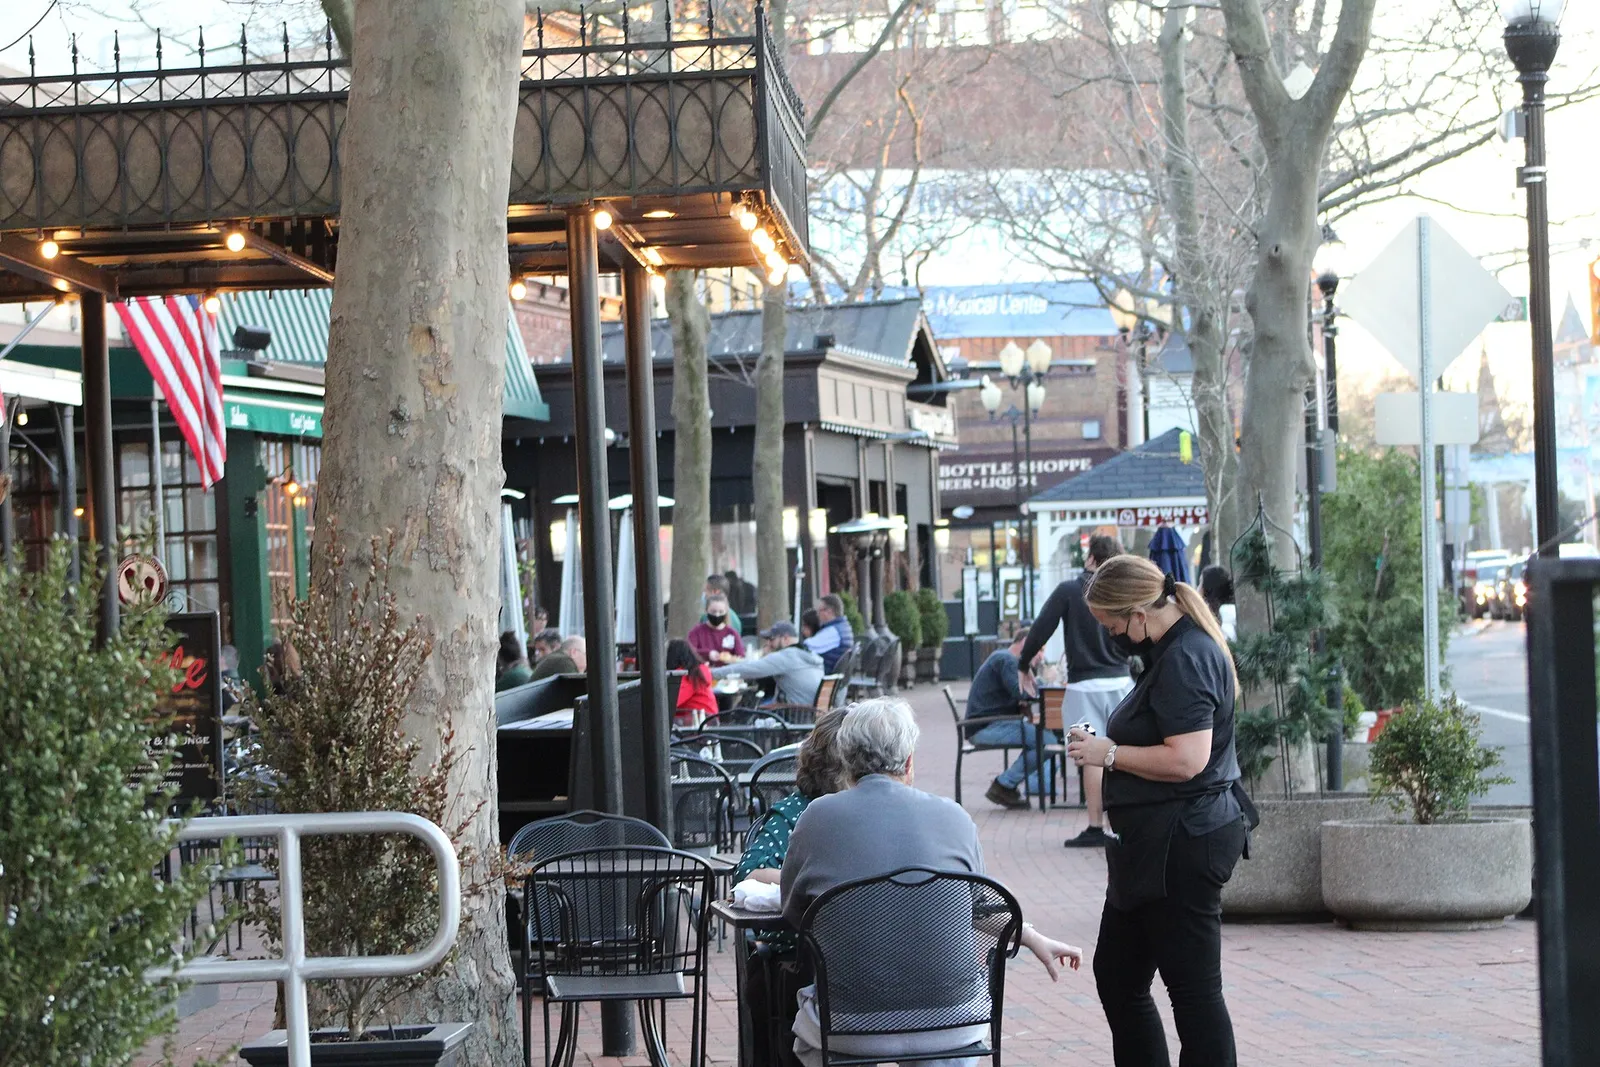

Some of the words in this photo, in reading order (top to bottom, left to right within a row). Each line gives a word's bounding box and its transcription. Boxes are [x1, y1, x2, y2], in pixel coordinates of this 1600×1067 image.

[939, 463, 1013, 478] BOTTLE
[1018, 457, 1093, 474] SHOPPE
[1137, 506, 1206, 518] DOWNTO
